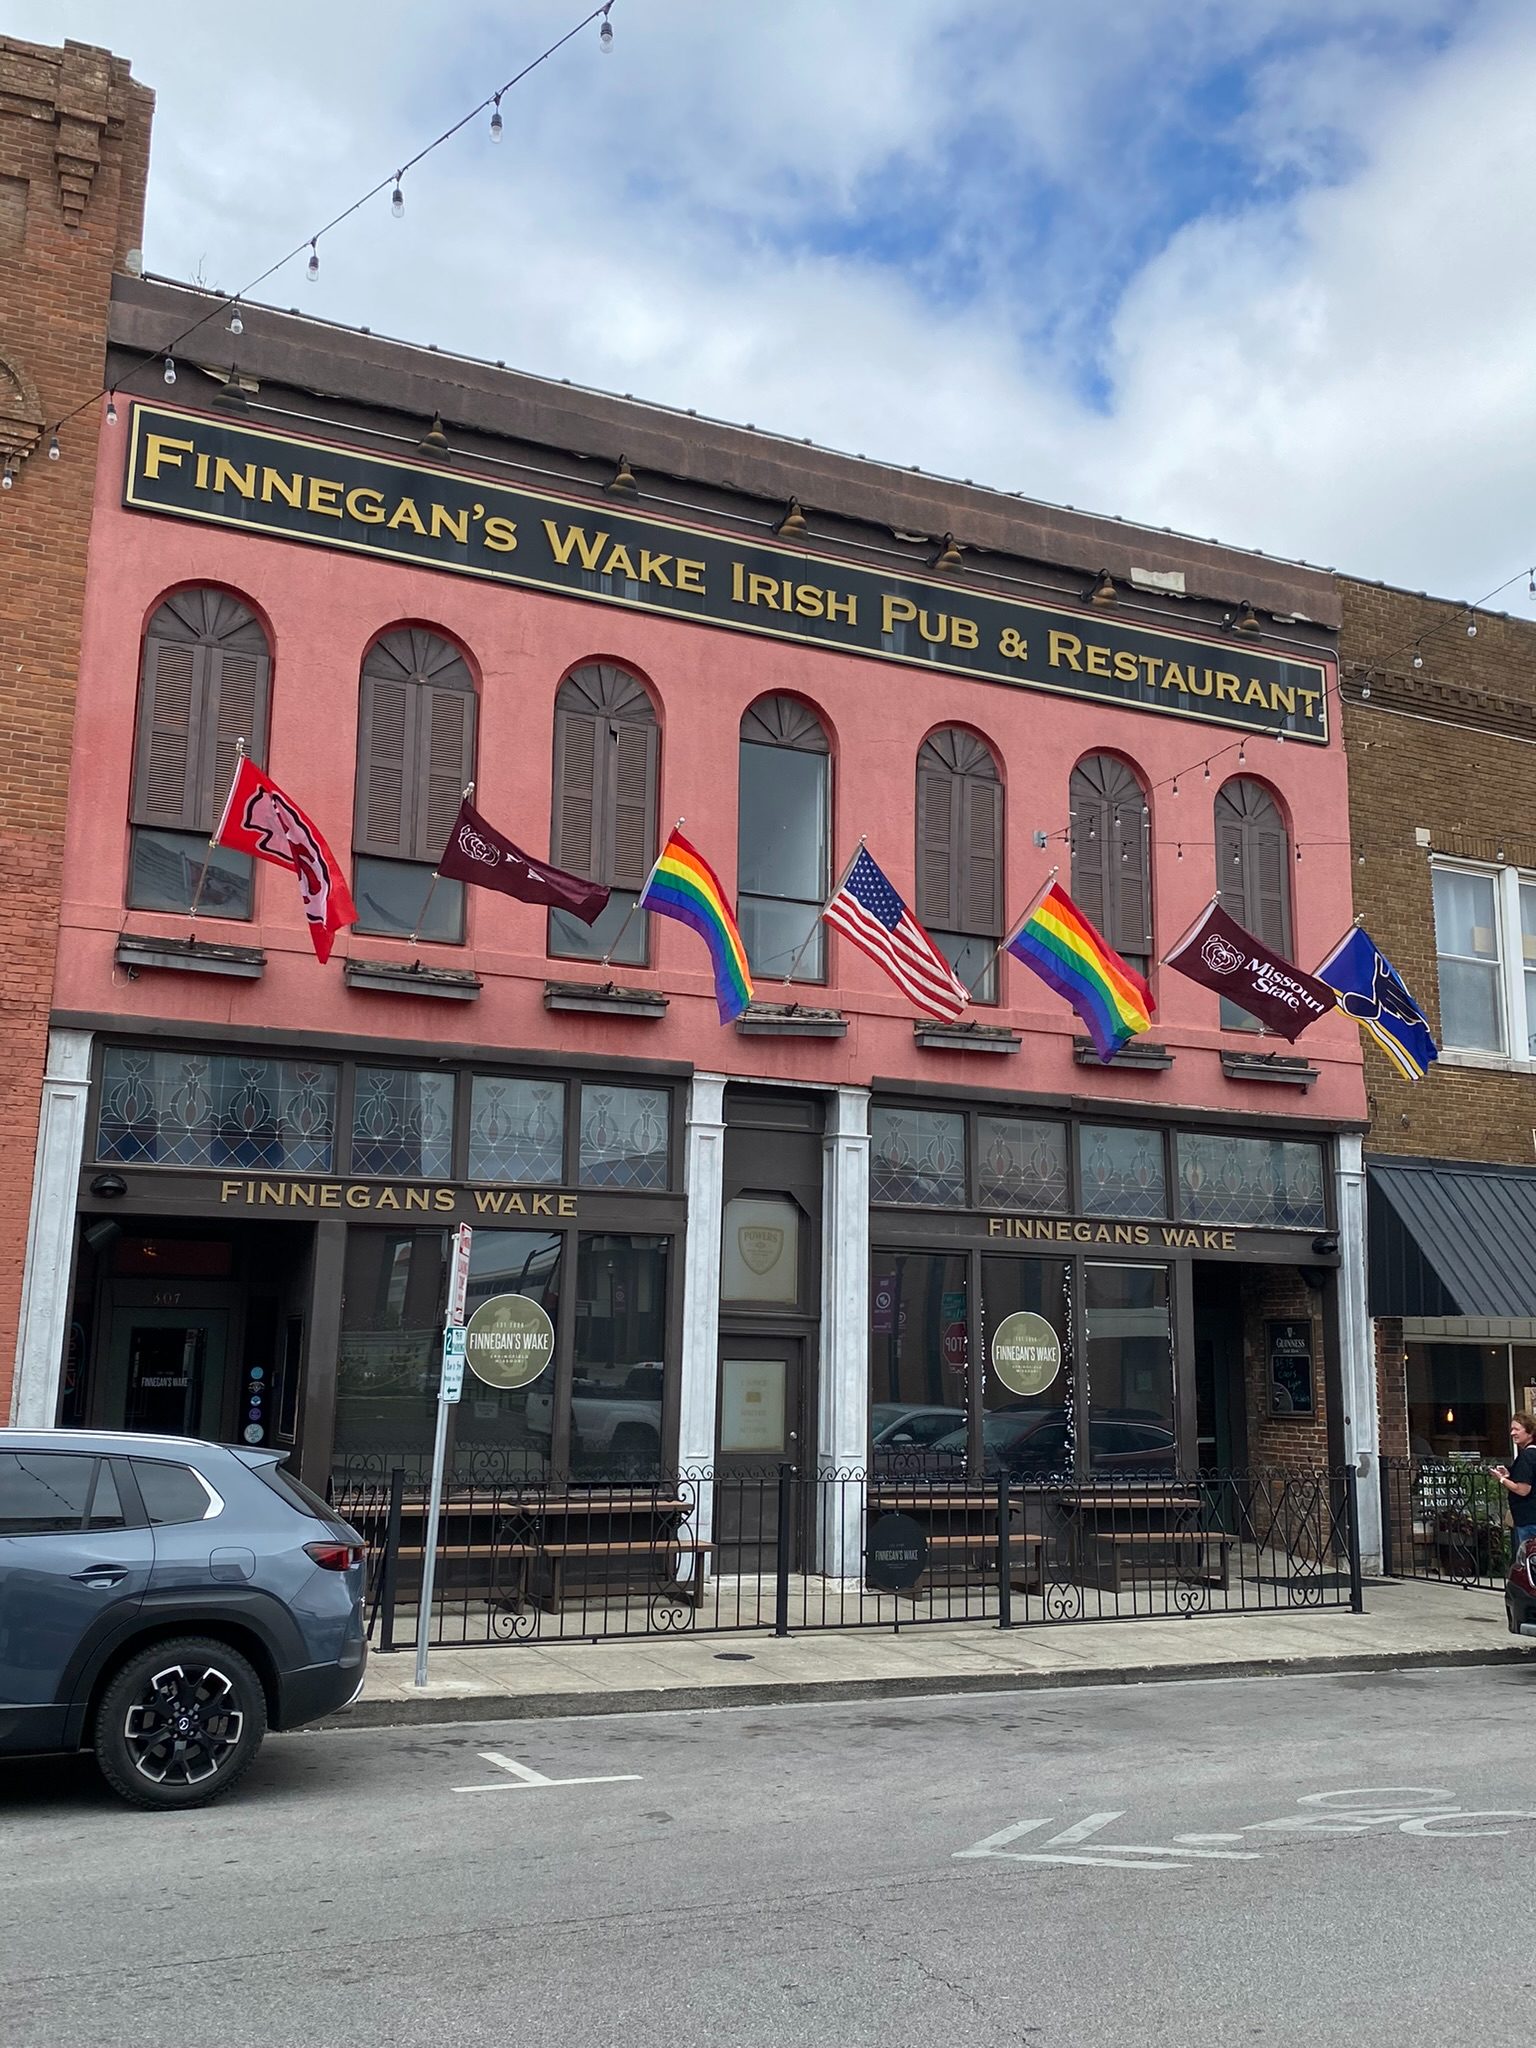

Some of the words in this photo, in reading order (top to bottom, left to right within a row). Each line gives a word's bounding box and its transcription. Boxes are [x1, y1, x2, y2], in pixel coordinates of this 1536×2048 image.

[142, 432, 518, 552] FINNEGAN'S
[540, 519, 706, 595] WAKE
[730, 561, 858, 626] IRISH
[880, 594, 980, 650] PUB
[998, 627, 1028, 661] &
[1048, 628, 1320, 718] RESTAURANT
[1243, 957, 1325, 1014] Missouri
[1251, 977, 1300, 1009] State
[220, 1180, 456, 1212] FINNEGANS
[475, 1190, 579, 1218] WAKE
[744, 1231, 778, 1243] POWERS
[987, 1217, 1150, 1247] FINNEGANS
[1163, 1226, 1237, 1252] WAKE
[446, 1332, 452, 1352] 2
[469, 1333, 521, 1350] FINNEGAN'S
[523, 1333, 549, 1350] WAKE
[996, 1345, 1036, 1361] FINNEGAN'S
[1036, 1346, 1057, 1362] WAKE
[1276, 1337, 1305, 1348] GUINNESS
